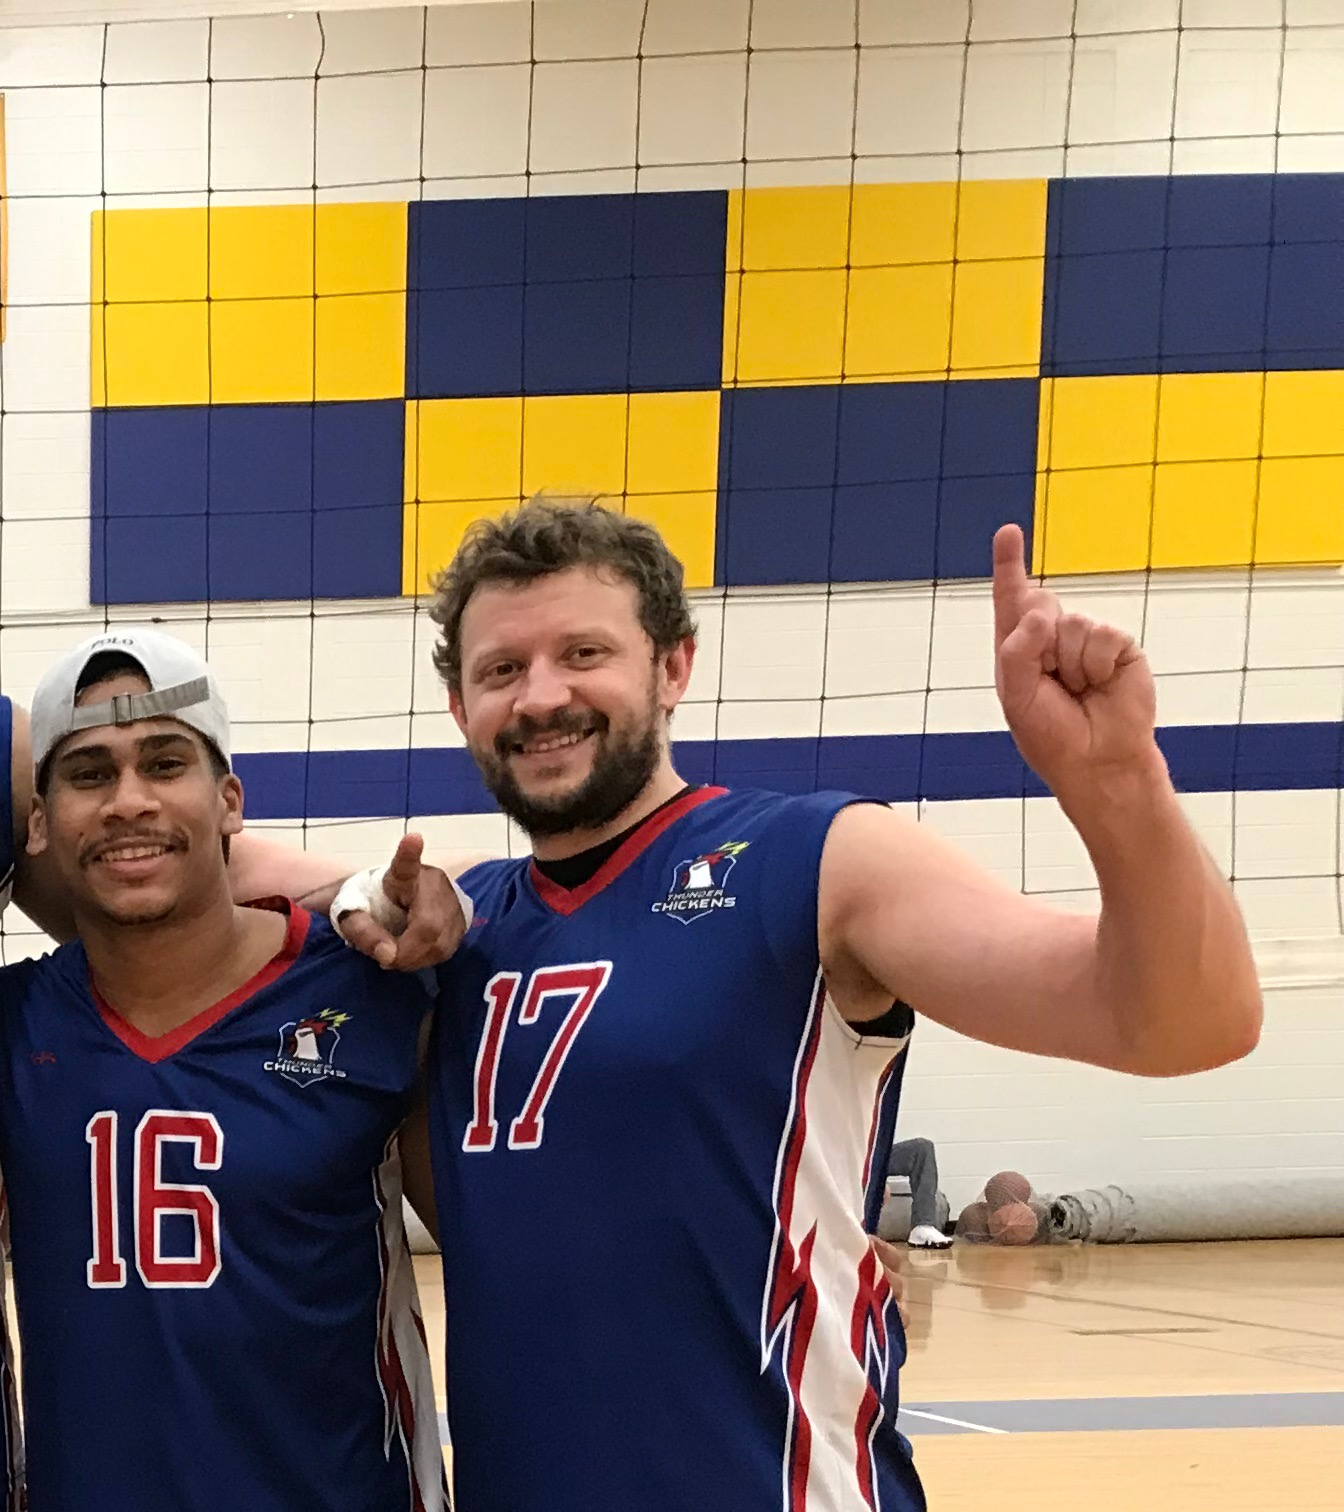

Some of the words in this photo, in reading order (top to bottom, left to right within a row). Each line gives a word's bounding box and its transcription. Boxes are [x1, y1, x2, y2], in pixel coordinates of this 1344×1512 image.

[667, 889, 724, 901] THUNDER
[651, 896, 737, 912] CHICKENS
[462, 960, 613, 1152] 17
[263, 1061, 347, 1078] CHICKENS
[86, 1109, 224, 1289] 16
